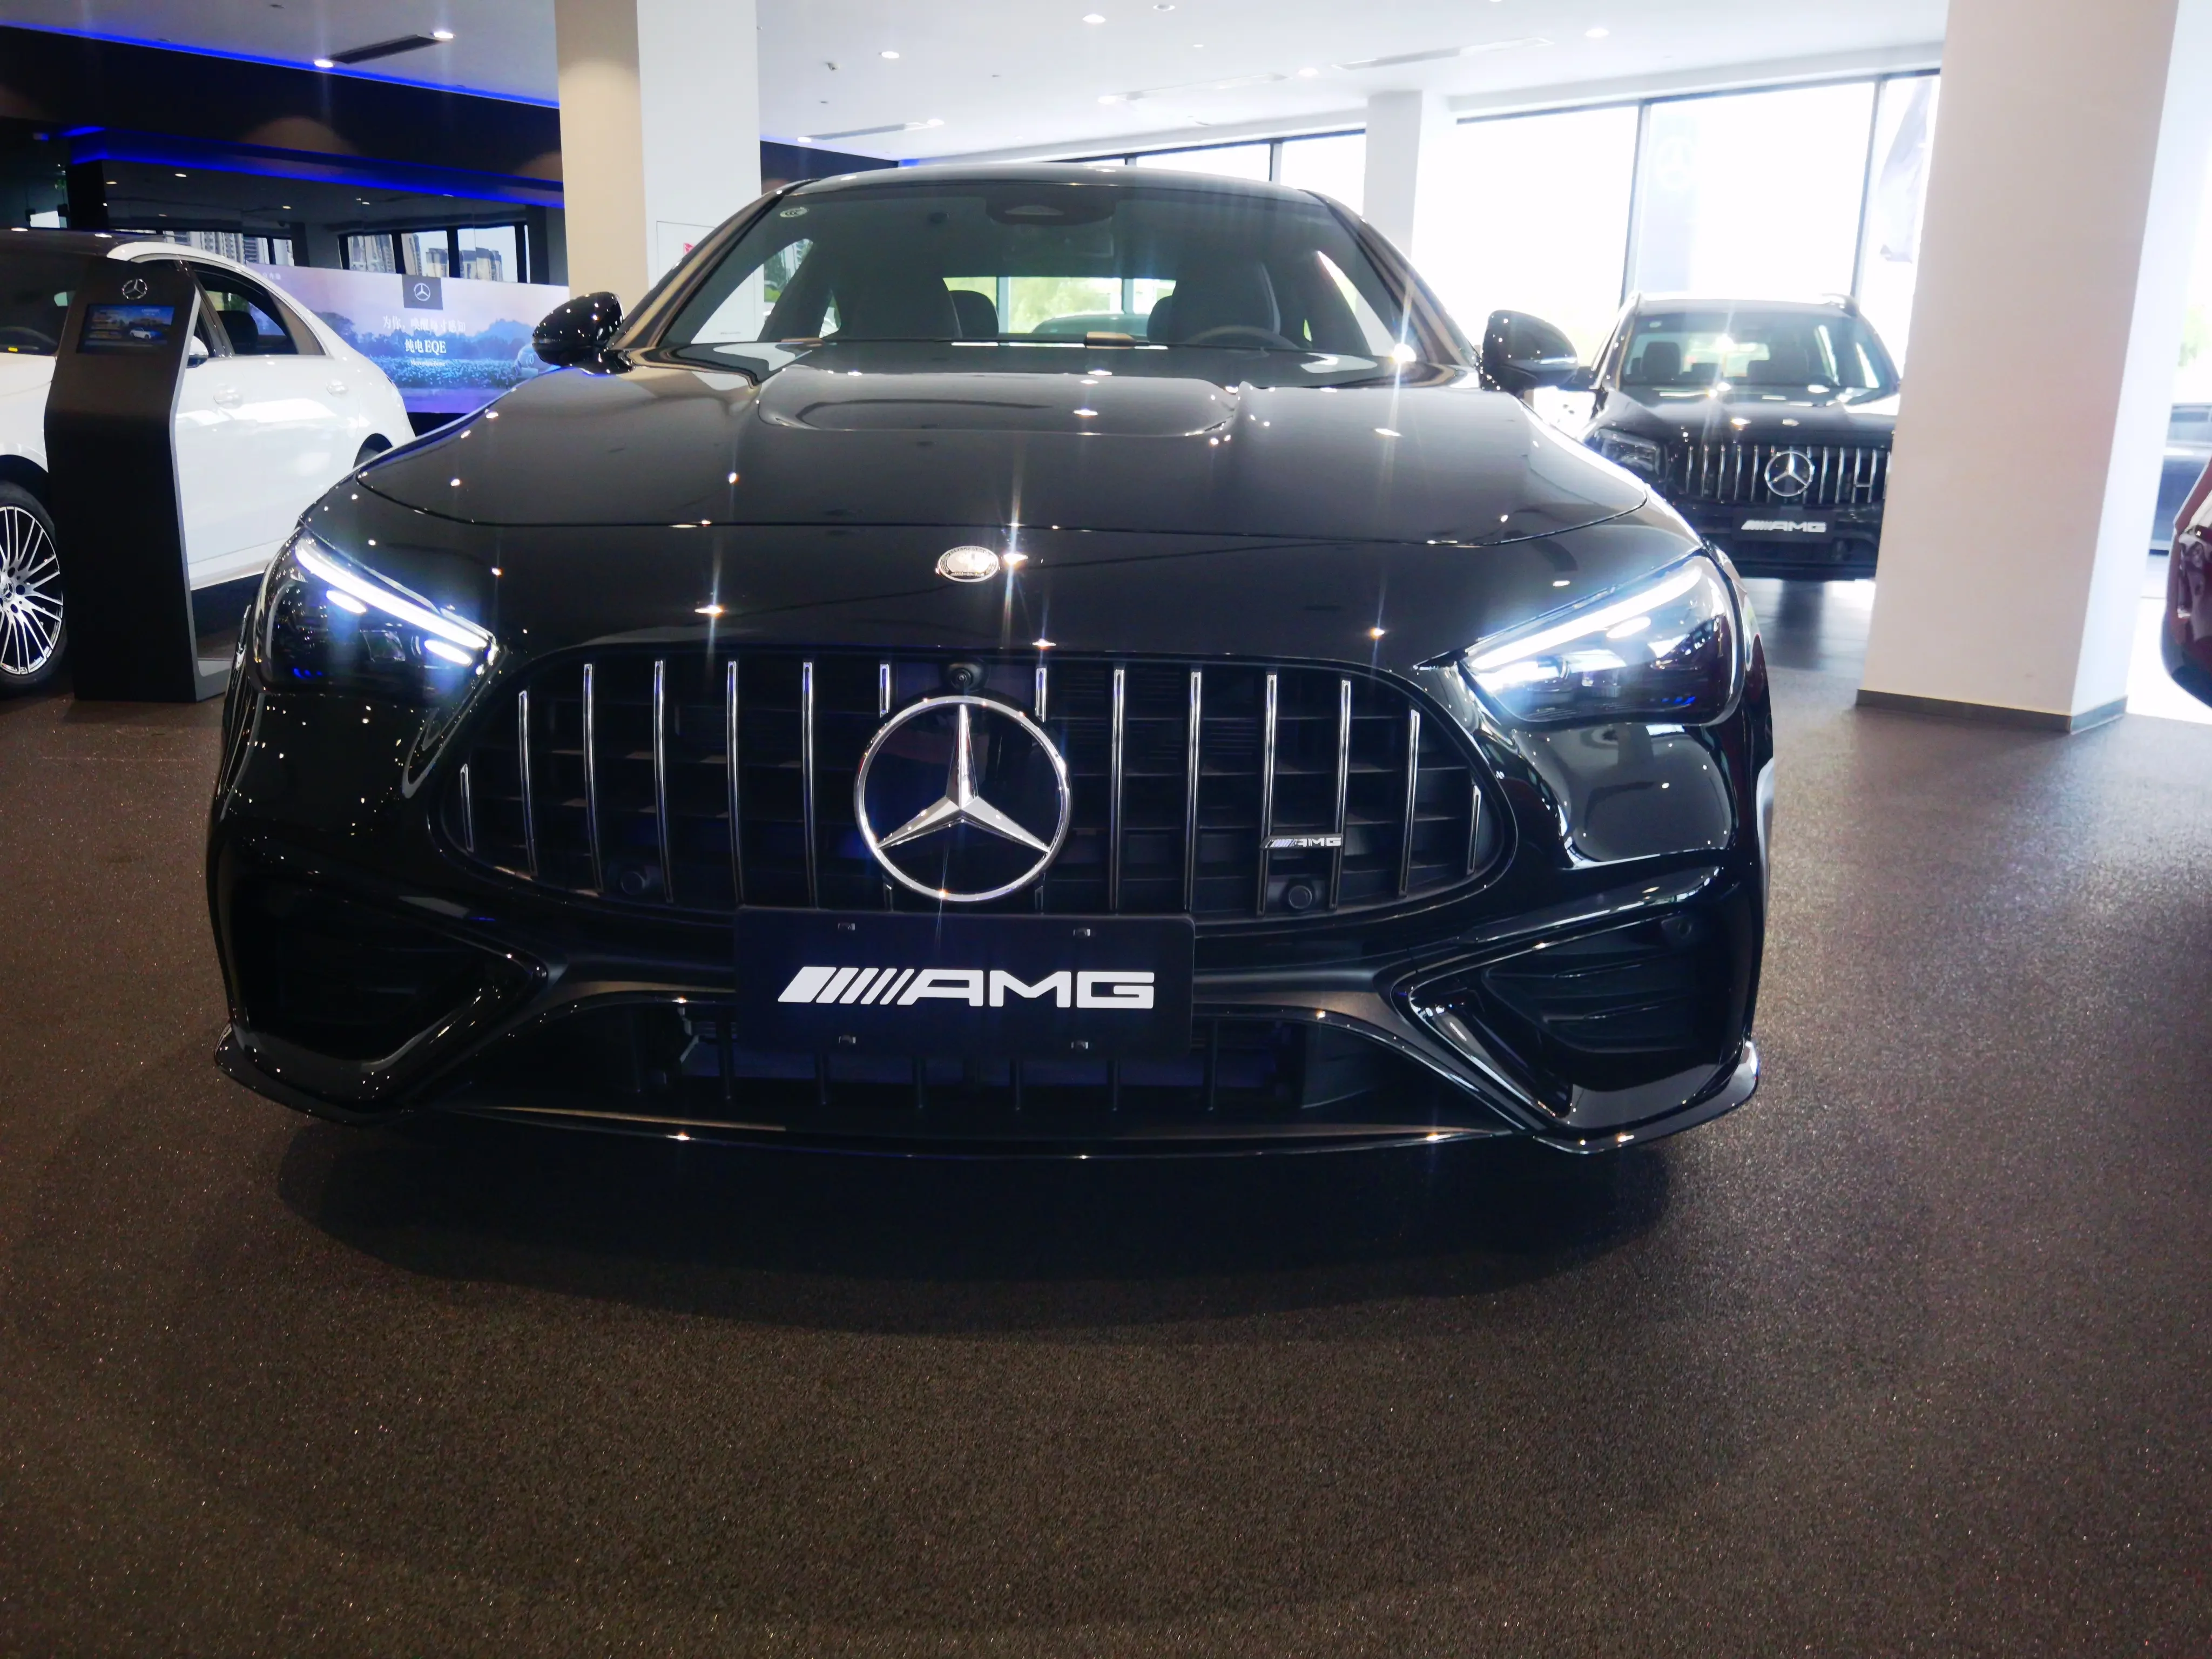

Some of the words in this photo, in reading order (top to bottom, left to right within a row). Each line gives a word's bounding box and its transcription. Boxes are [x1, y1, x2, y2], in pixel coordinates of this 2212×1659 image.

[1768, 520, 1826, 532] AMG
[1290, 838, 1341, 847] AMG
[896, 969, 1155, 1009] AMG
